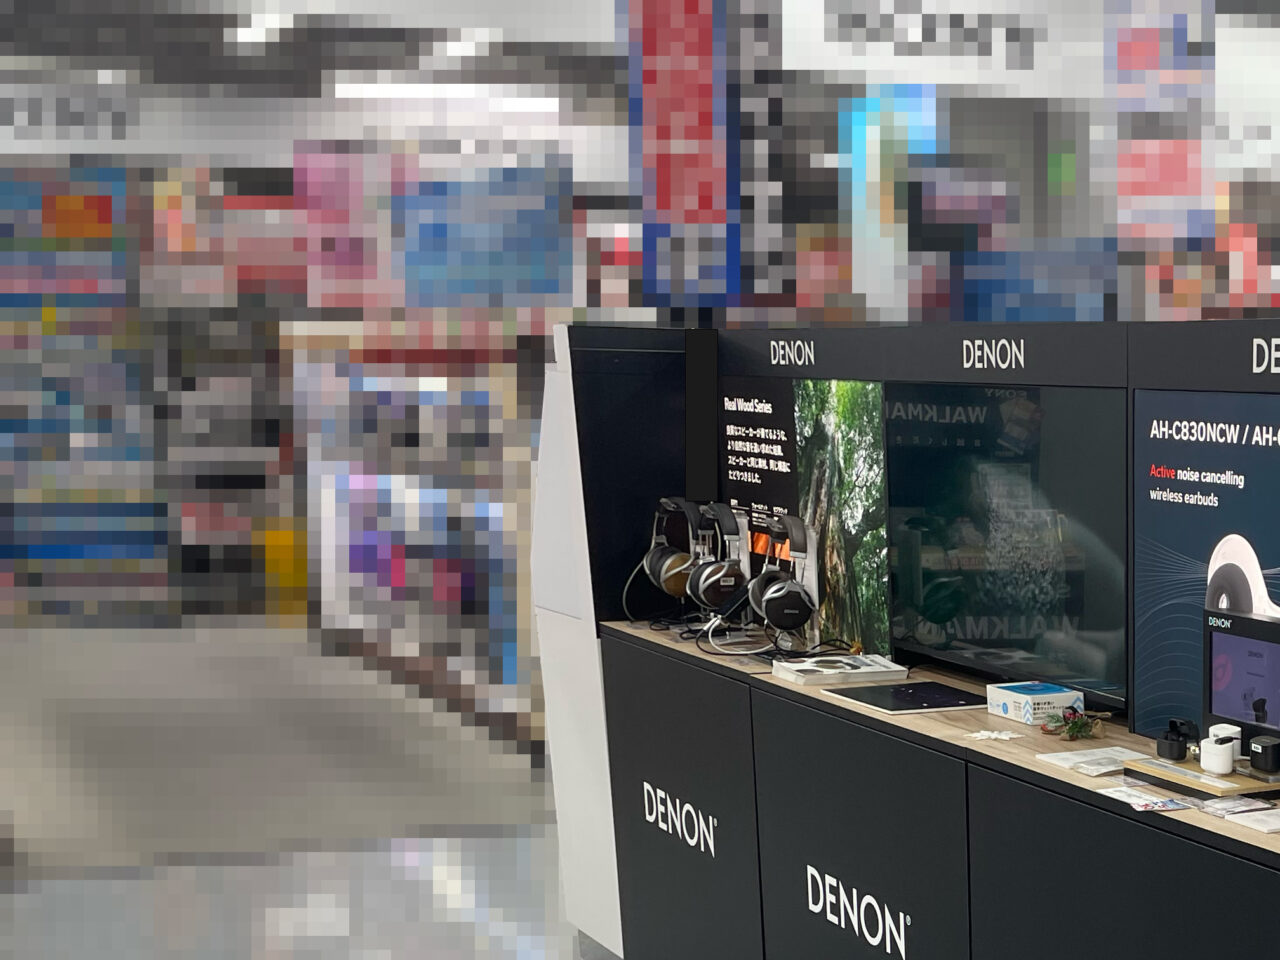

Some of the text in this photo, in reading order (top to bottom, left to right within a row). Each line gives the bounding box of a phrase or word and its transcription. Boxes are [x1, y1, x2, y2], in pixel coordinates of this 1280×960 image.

[770, 340, 815, 366] DENON
[962, 339, 1024, 369] DENON
[724, 397, 773, 414] Real Wood Series
[1150, 419, 1240, 445] AH-C830NCW
[1150, 464, 1245, 489] Active noise cancelling
[1150, 487, 1219, 507] wireless earbuds
[1208, 616, 1231, 629] DENON
